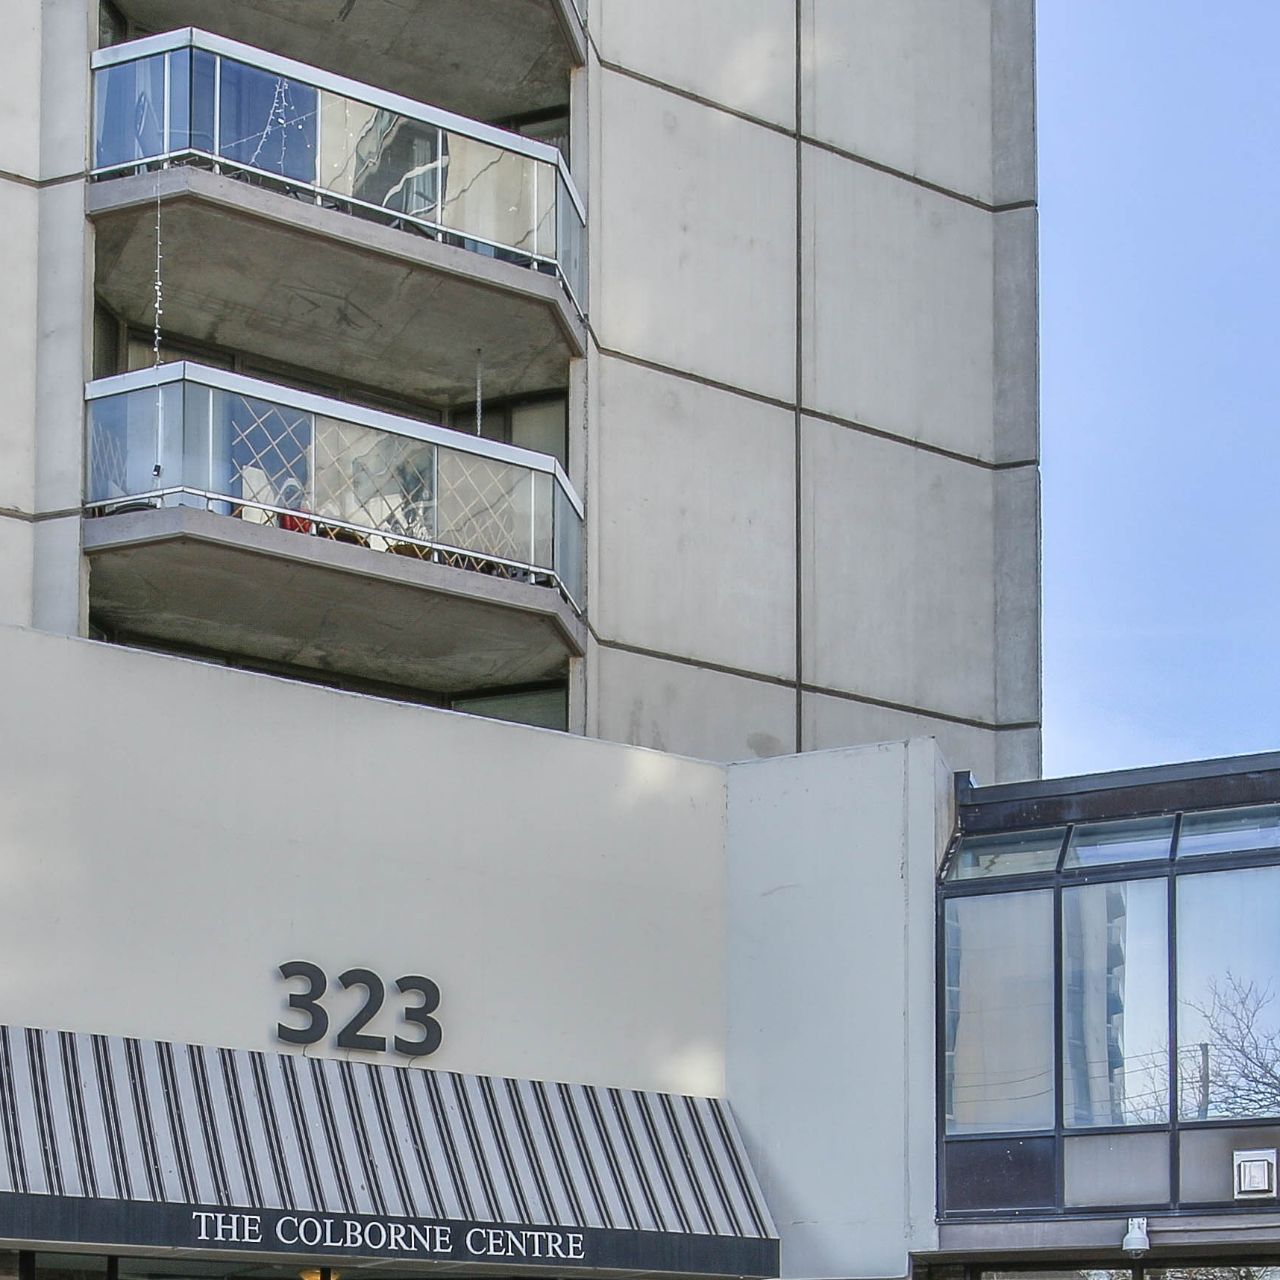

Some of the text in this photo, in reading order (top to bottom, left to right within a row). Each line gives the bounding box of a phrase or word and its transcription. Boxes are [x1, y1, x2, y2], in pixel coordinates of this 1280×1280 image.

[277, 960, 443, 1056] 323
[192, 1211, 586, 1259] THE COLBORNE CENTRE
